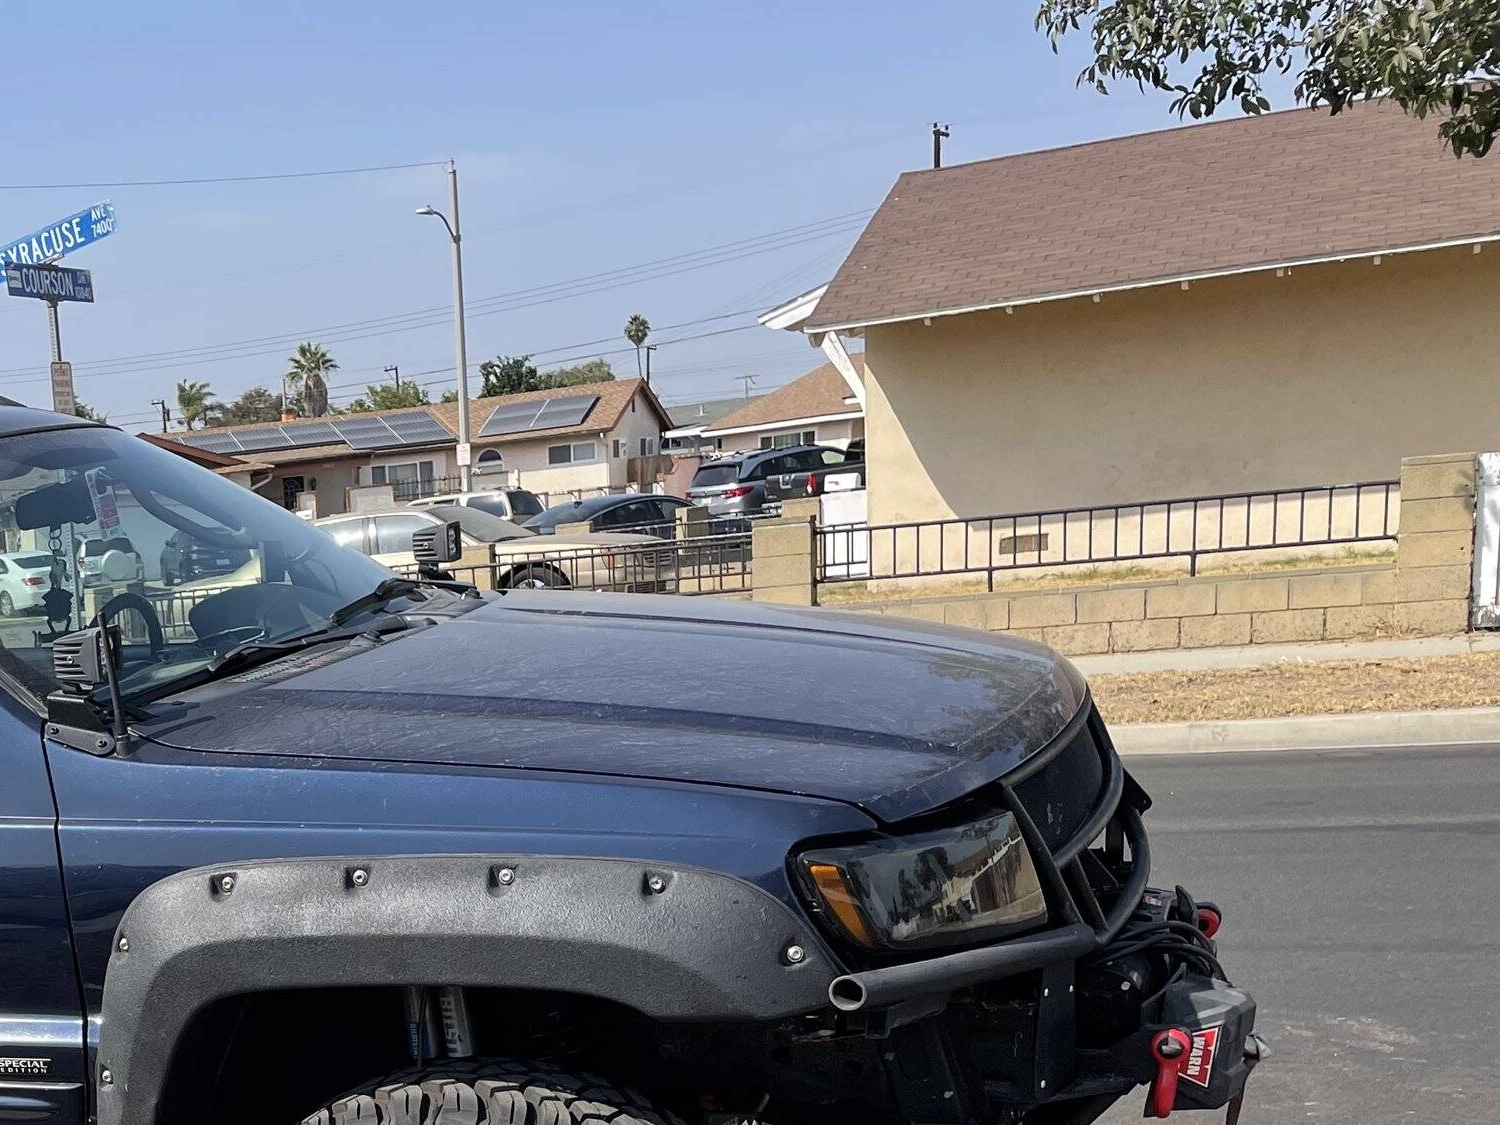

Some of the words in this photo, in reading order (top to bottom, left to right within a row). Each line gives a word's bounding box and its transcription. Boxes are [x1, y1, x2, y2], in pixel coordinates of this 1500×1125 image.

[91, 205, 107, 222] AVE
[21, 267, 75, 297] COURSON
[1186, 1036, 1206, 1076] WARN
